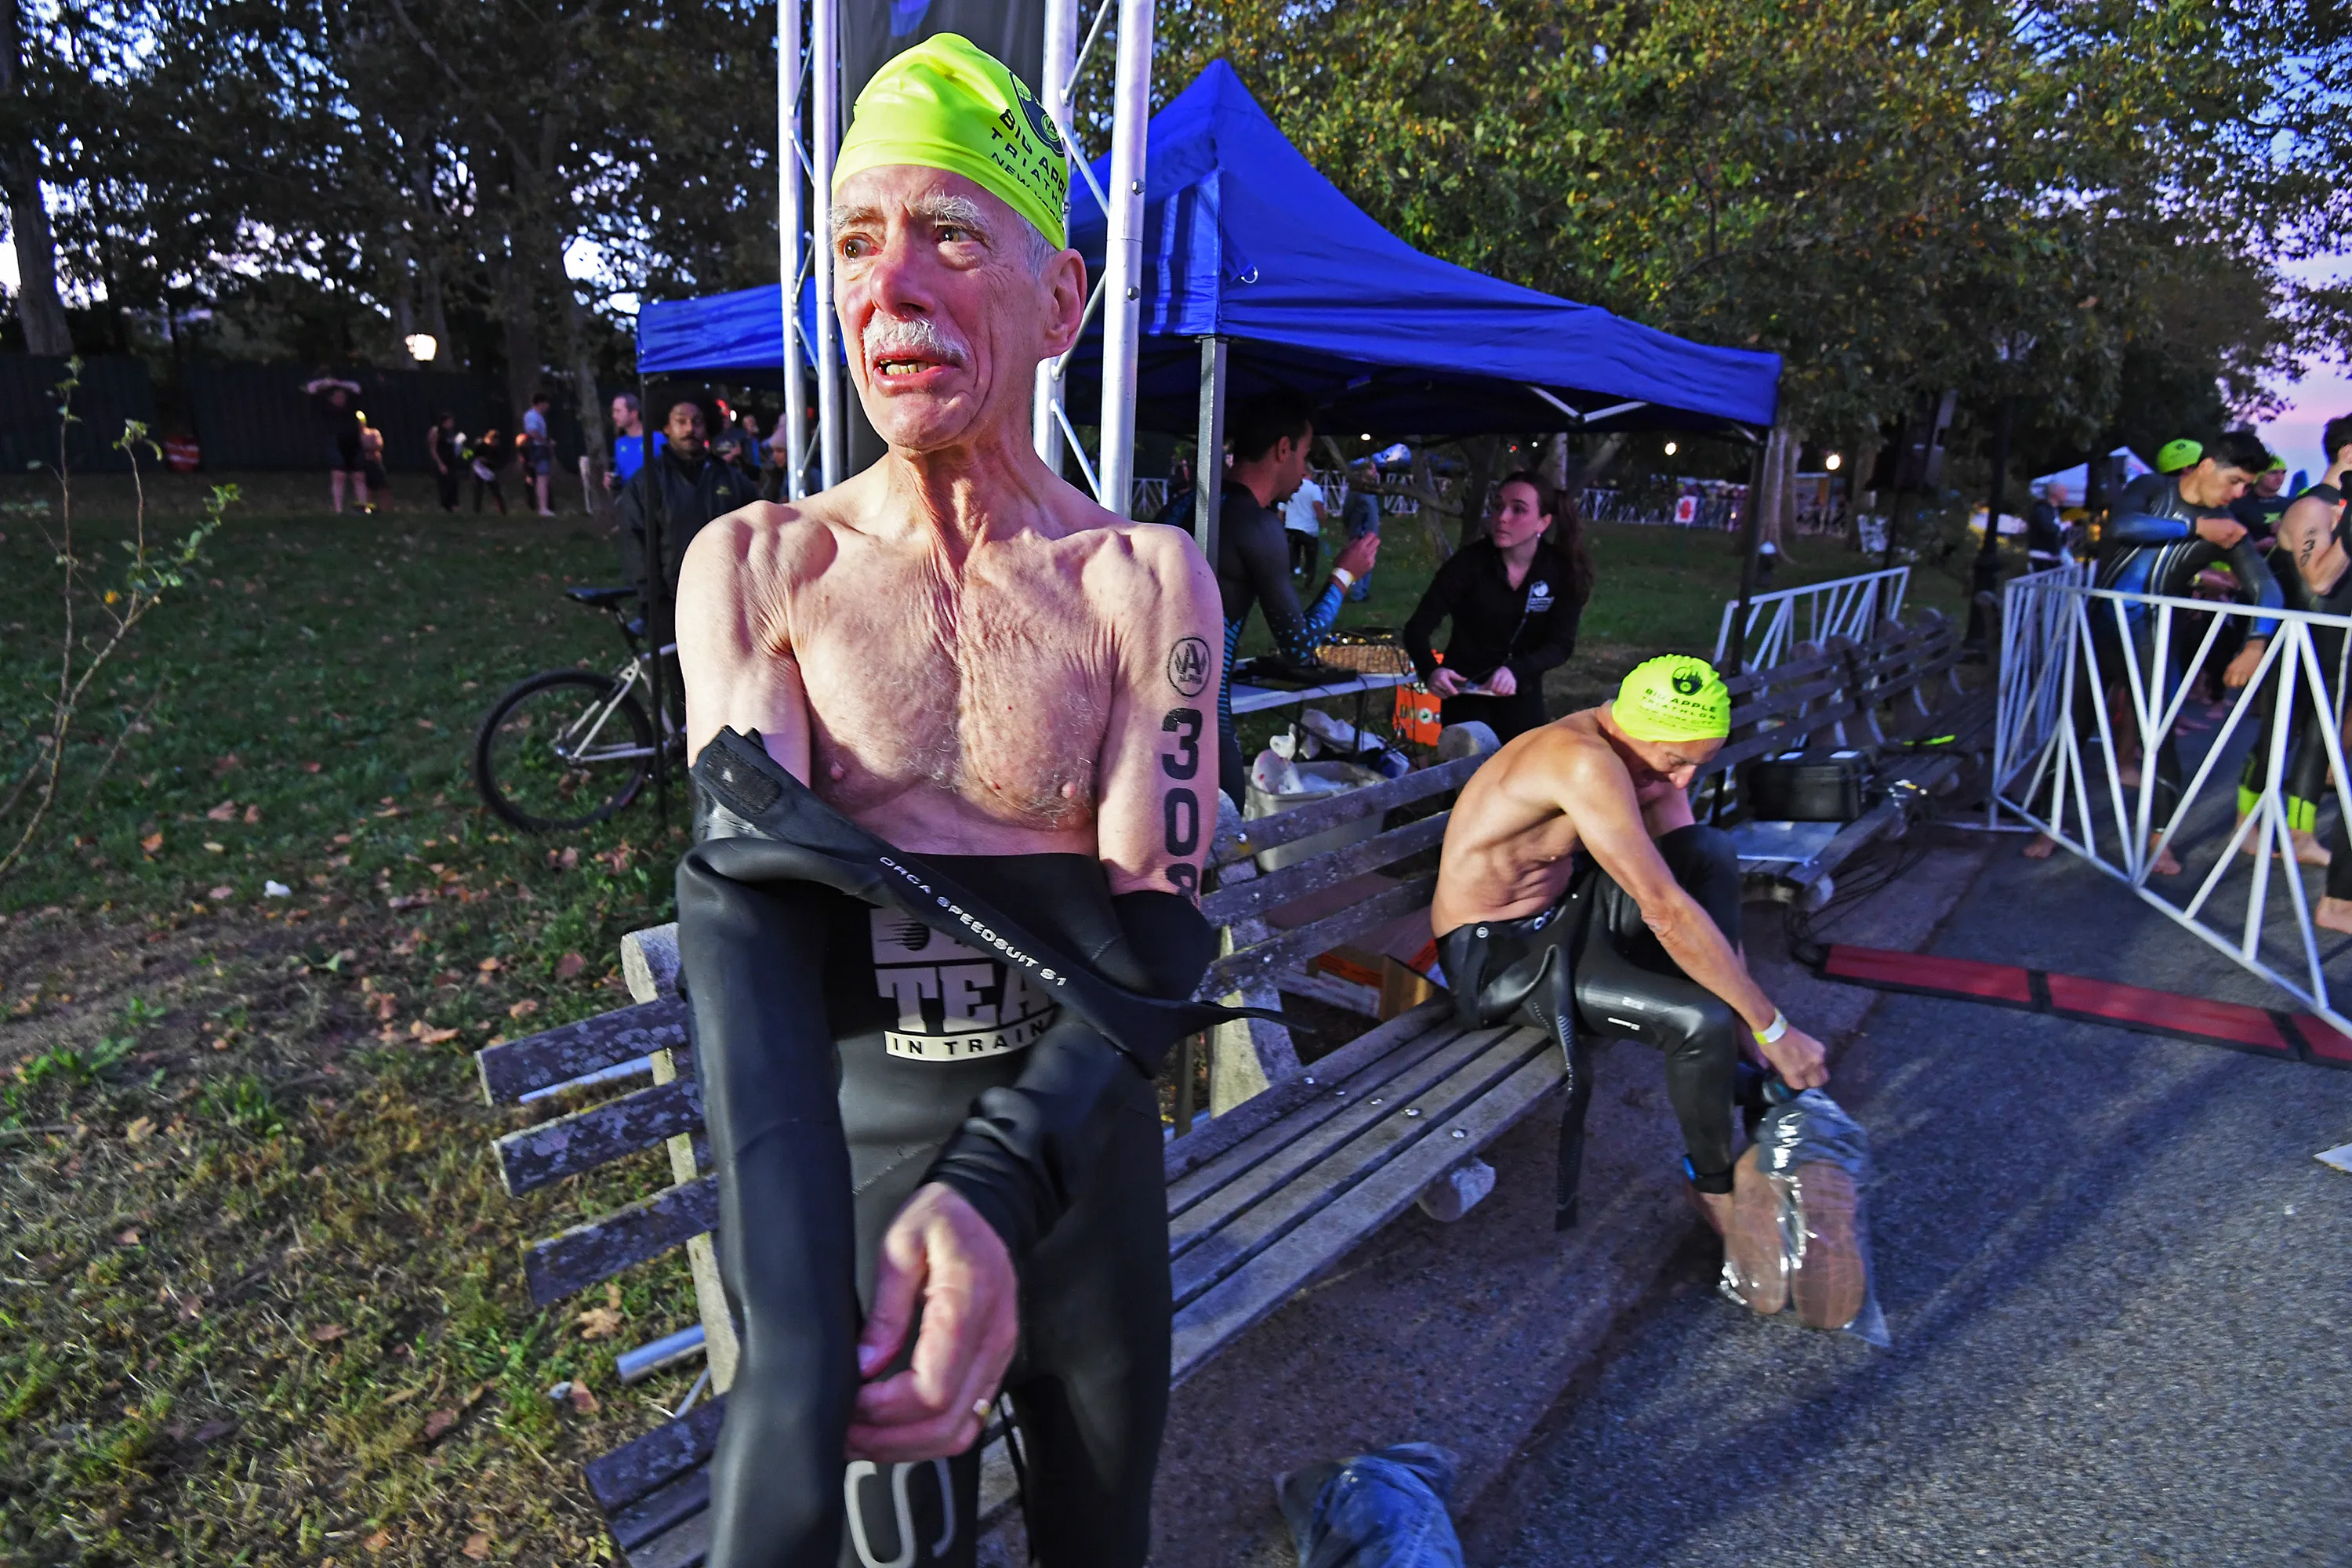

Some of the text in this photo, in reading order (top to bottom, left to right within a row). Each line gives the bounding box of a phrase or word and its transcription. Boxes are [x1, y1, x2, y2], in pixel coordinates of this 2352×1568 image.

[1670, 697, 1717, 713] APPLE
[880, 856, 1067, 985] ORCA SPEEDSUIT S1
[893, 1037, 923, 1055] IN
